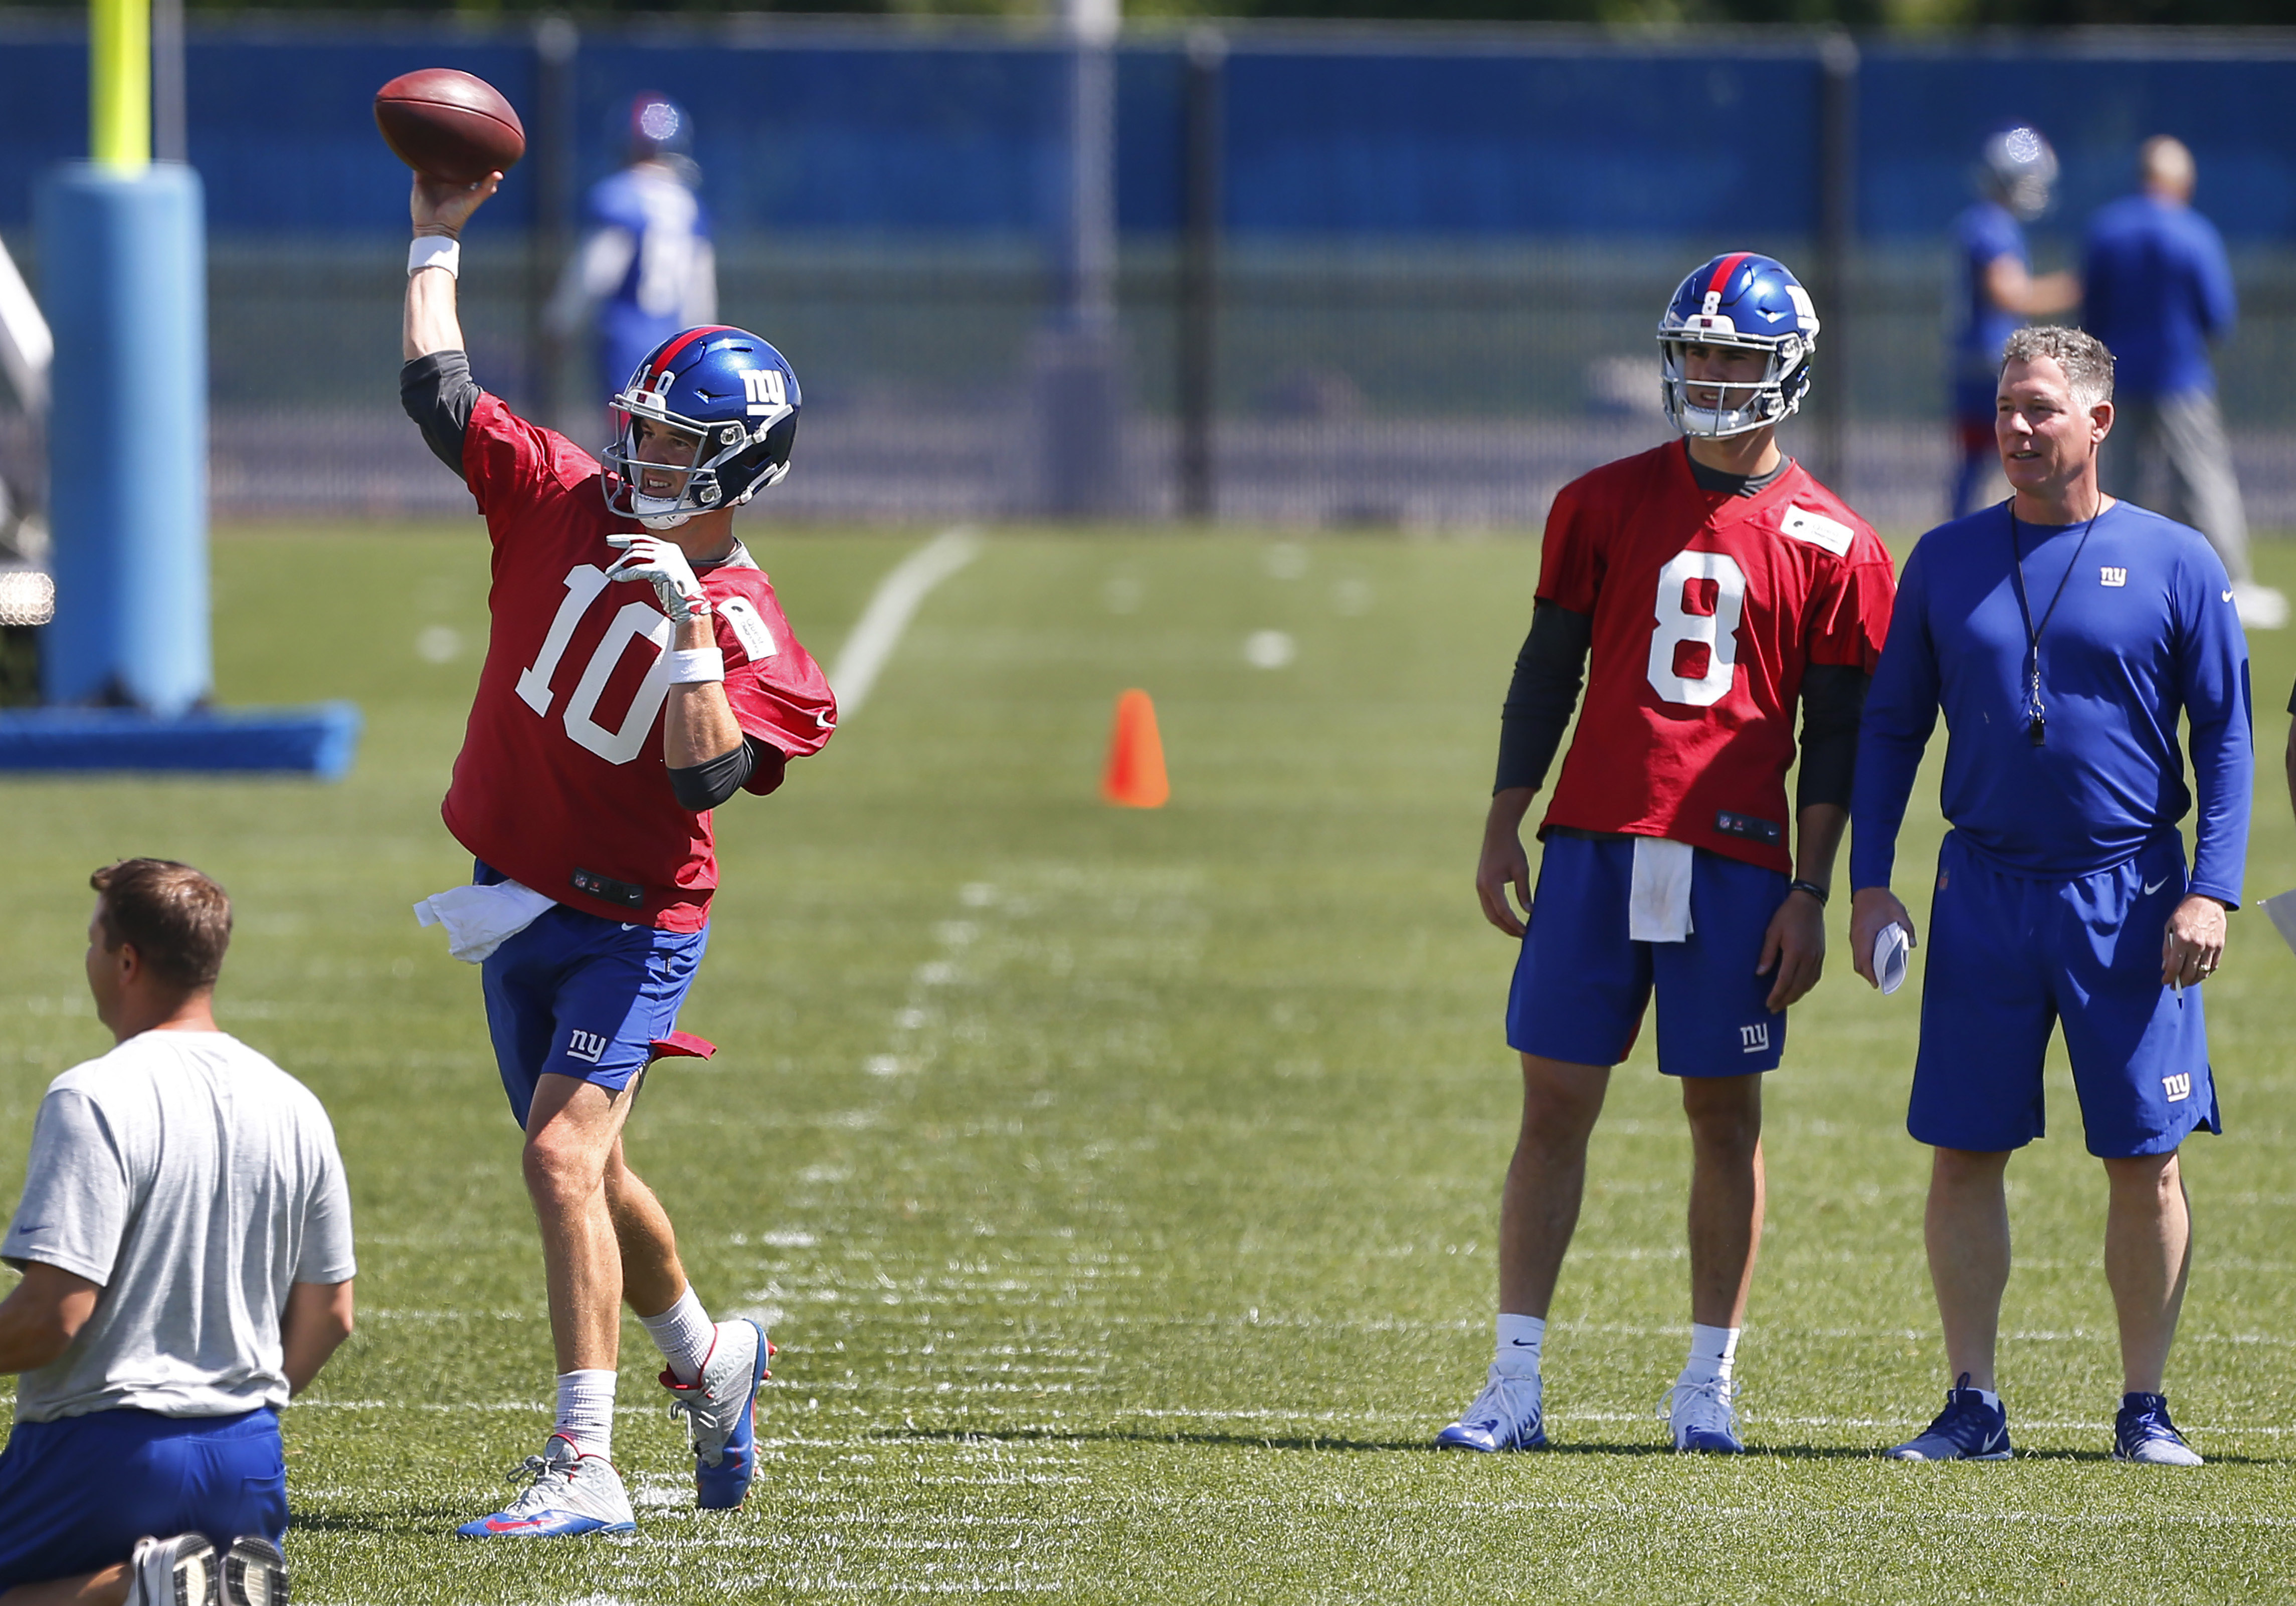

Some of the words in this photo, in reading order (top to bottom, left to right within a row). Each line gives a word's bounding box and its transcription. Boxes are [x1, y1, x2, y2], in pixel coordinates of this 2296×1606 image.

[1701, 291, 1722, 315] 8
[636, 364, 676, 396] 10
[2100, 567, 2127, 587] ny
[1647, 549, 1747, 707] 8
[514, 563, 677, 765] 10
[566, 1029, 607, 1063] ny
[1740, 1023, 1770, 1054] ny
[2162, 1072, 2190, 1103] ny
